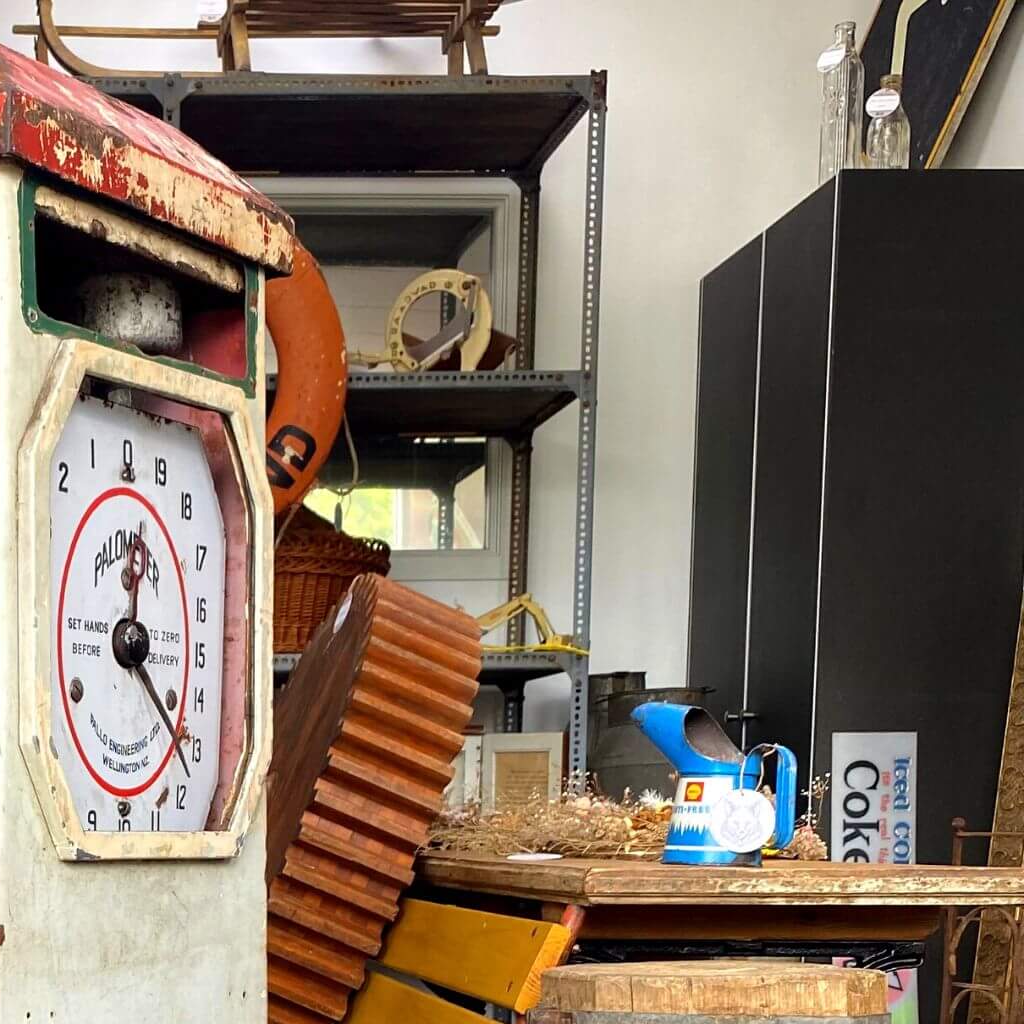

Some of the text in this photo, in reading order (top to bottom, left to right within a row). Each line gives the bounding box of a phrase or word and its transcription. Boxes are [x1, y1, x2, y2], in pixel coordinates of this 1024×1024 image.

[90, 438, 95, 469] 1
[123, 439, 133, 468] 0
[58, 461, 69, 493] 2
[154, 456, 167, 486] 19
[181, 491, 192, 521] 18
[94, 528, 160, 599] PALOMER
[195, 543, 207, 572] 17
[196, 597, 207, 623] 16
[68, 617, 181, 644] SET HANDS TO ZERO
[72, 642, 180, 667] BEFORE DELIVERY
[195, 642, 206, 669] 15
[194, 687, 204, 713] 14
[108, 734, 148, 756] ENGINEERING
[192, 735, 202, 763] 13
[102, 753, 140, 775] WELLINGTON
[176, 785, 186, 810] 12
[87, 809, 97, 832] 9
[151, 810, 160, 832] 11
[842, 759, 881, 864] Coke
